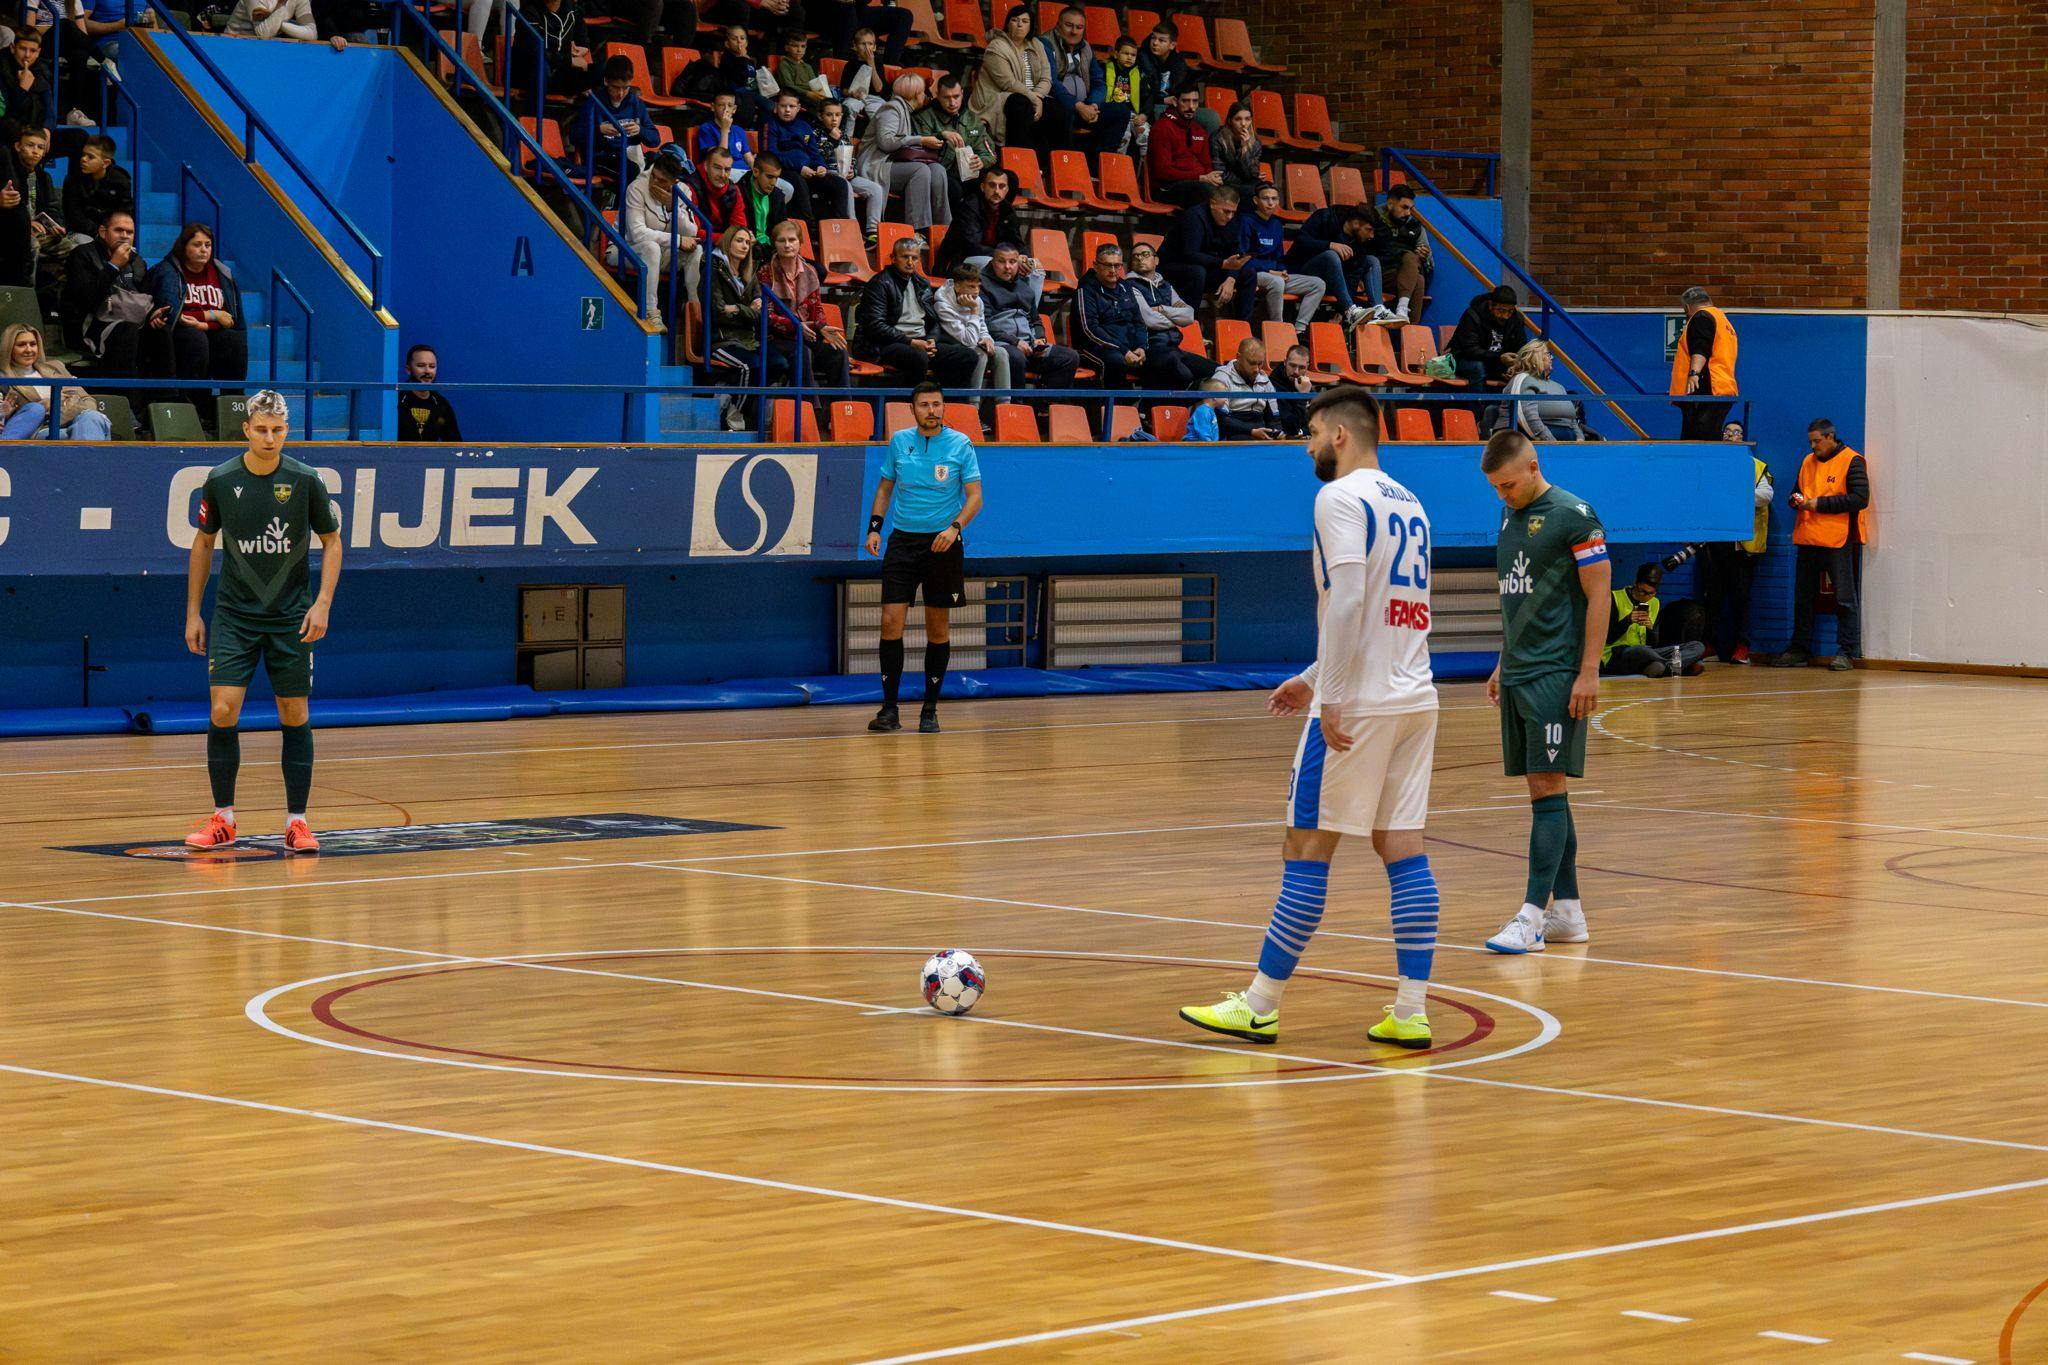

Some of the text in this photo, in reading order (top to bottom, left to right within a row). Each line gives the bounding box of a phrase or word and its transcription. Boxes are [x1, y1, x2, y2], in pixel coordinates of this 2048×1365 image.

[1062, 155, 1069, 163] 8
[1297, 168, 1302, 176] 3
[832, 224, 840, 233] 12
[511, 236, 534, 276] A
[6, 292, 12, 302] 3
[185, 283, 224, 309] OSTON
[99, 401, 105, 411] 3
[232, 402, 244, 412] 30
[166, 410, 171, 418] 1
[1164, 409, 1170, 419] 9
[1827, 475, 1836, 484] 64
[238, 535, 291, 554] wibit
[1388, 512, 1429, 590] 23
[1389, 598, 1429, 631] FAKS
[1544, 722, 1563, 745] 10
